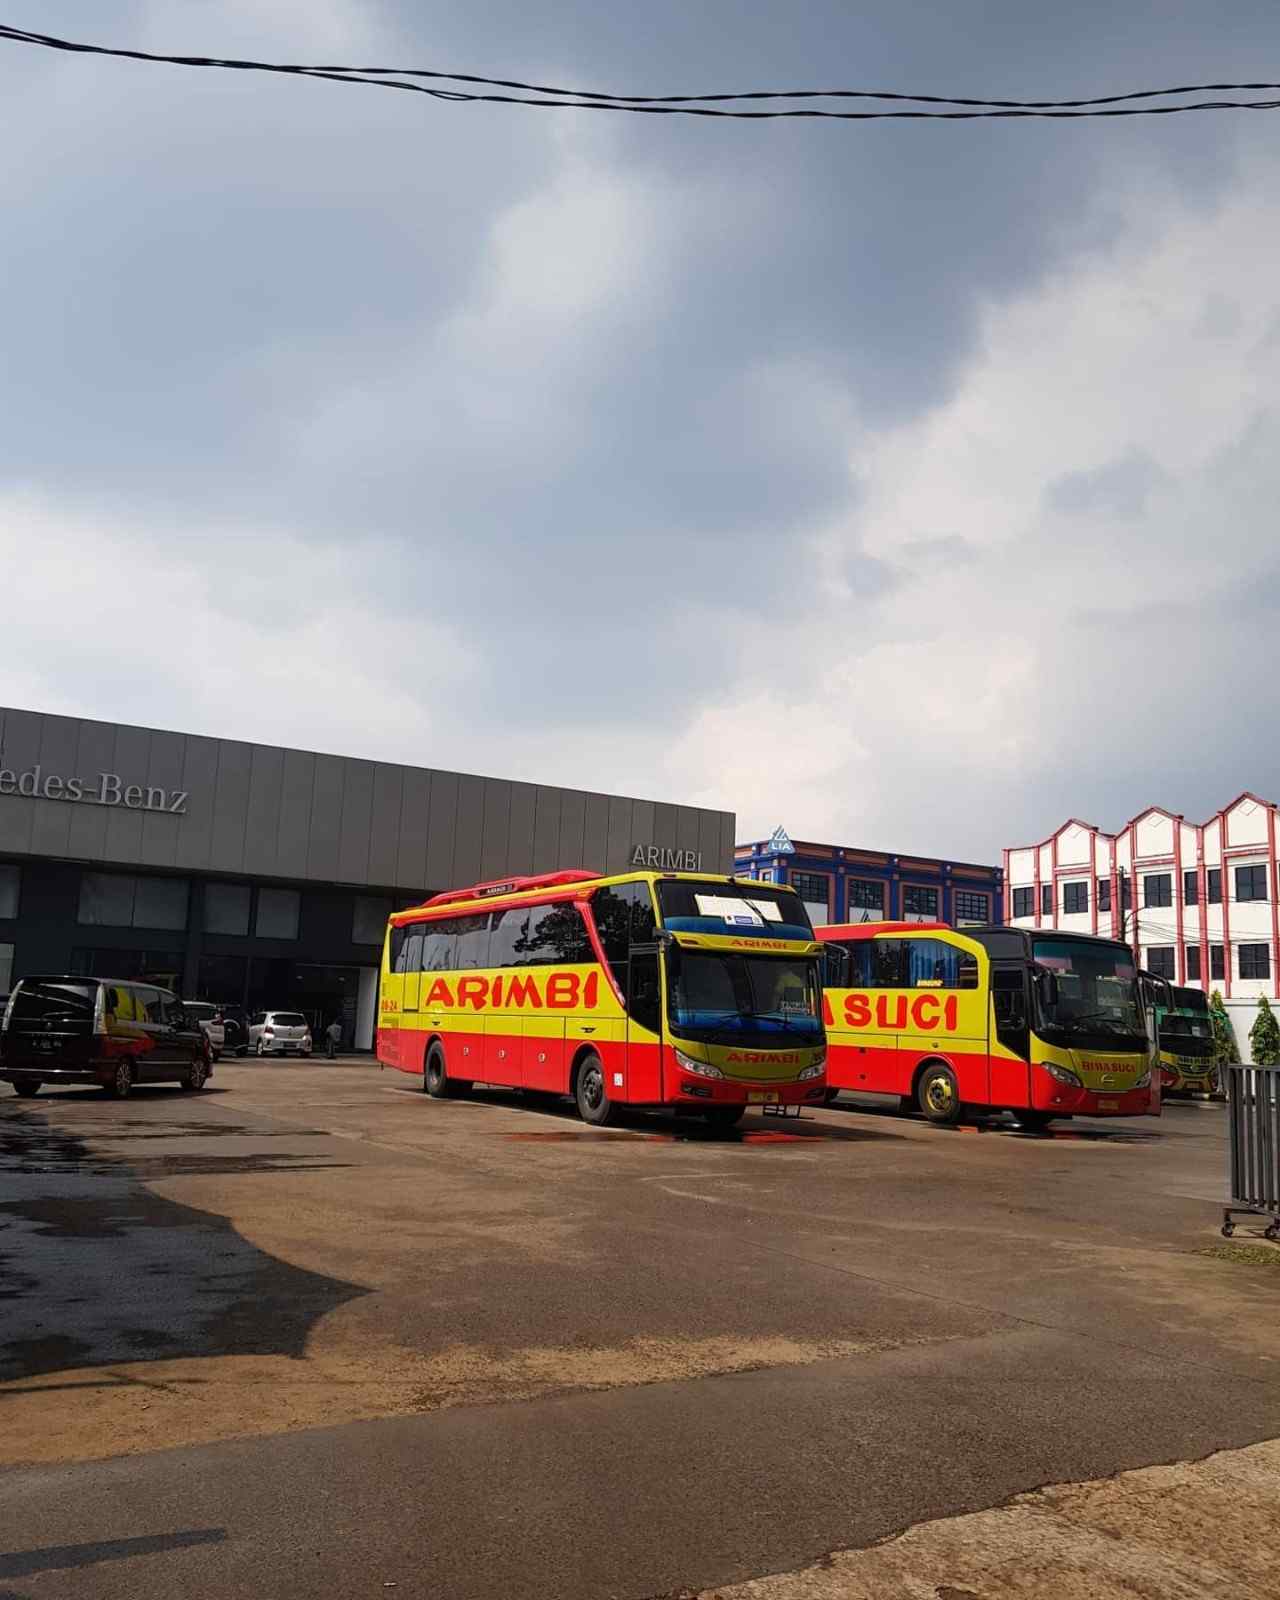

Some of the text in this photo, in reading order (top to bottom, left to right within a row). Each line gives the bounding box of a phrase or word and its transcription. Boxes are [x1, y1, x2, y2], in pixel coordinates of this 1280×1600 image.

[0, 765, 188, 813] edes-Benz
[632, 844, 702, 872] ARIMBI
[731, 939, 786, 949] ARIMBI
[426, 971, 598, 1010] ARIMBI
[727, 1052, 800, 1063] ARIMBI
